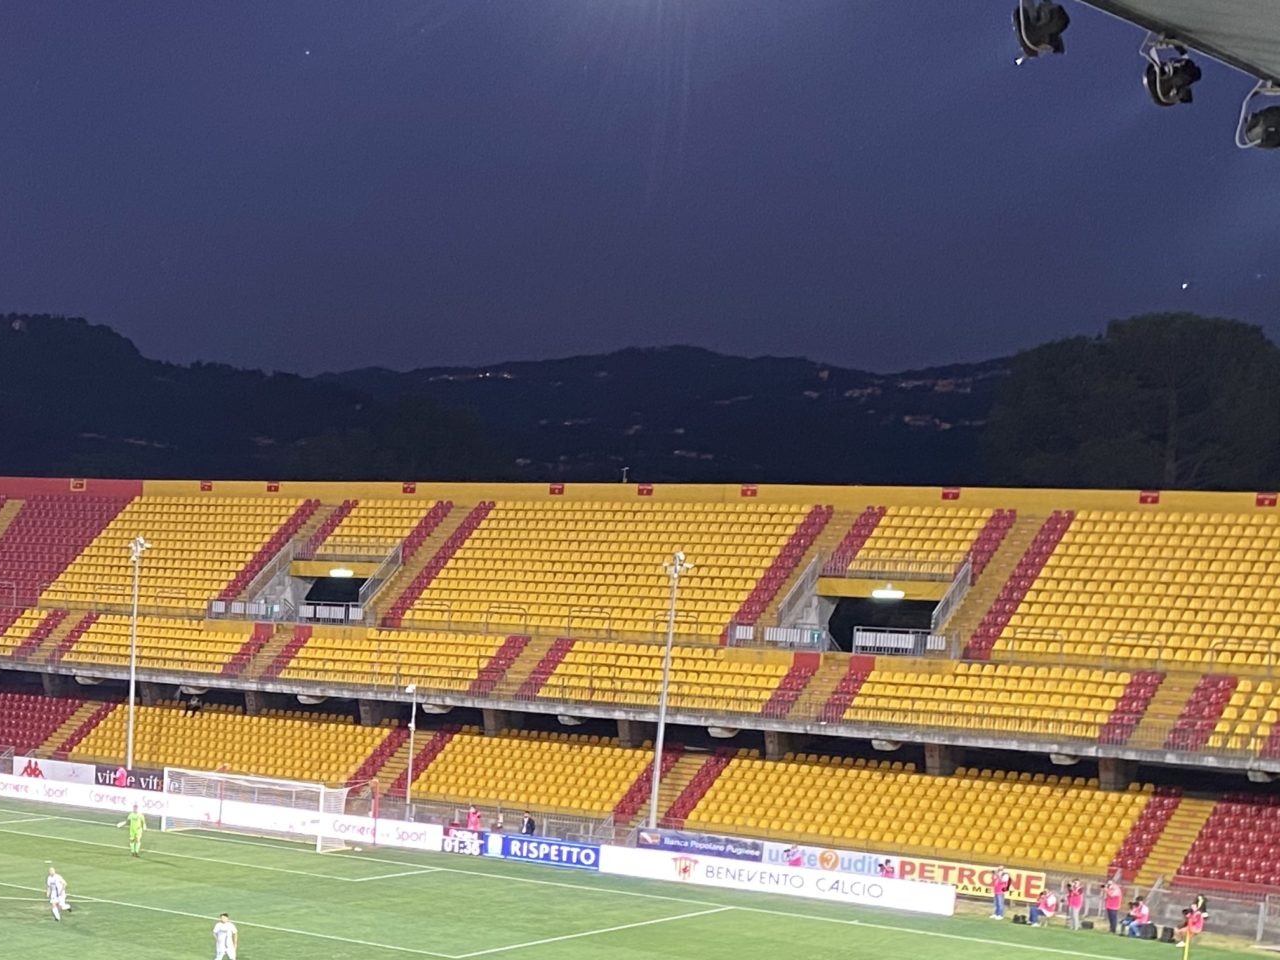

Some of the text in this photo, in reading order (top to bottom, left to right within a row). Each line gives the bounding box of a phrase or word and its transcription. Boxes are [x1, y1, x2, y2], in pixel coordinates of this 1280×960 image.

[510, 841, 596, 865] RISPETTO
[664, 837, 689, 847] Banca
[705, 865, 884, 898] BENEVENTO CALCIO
